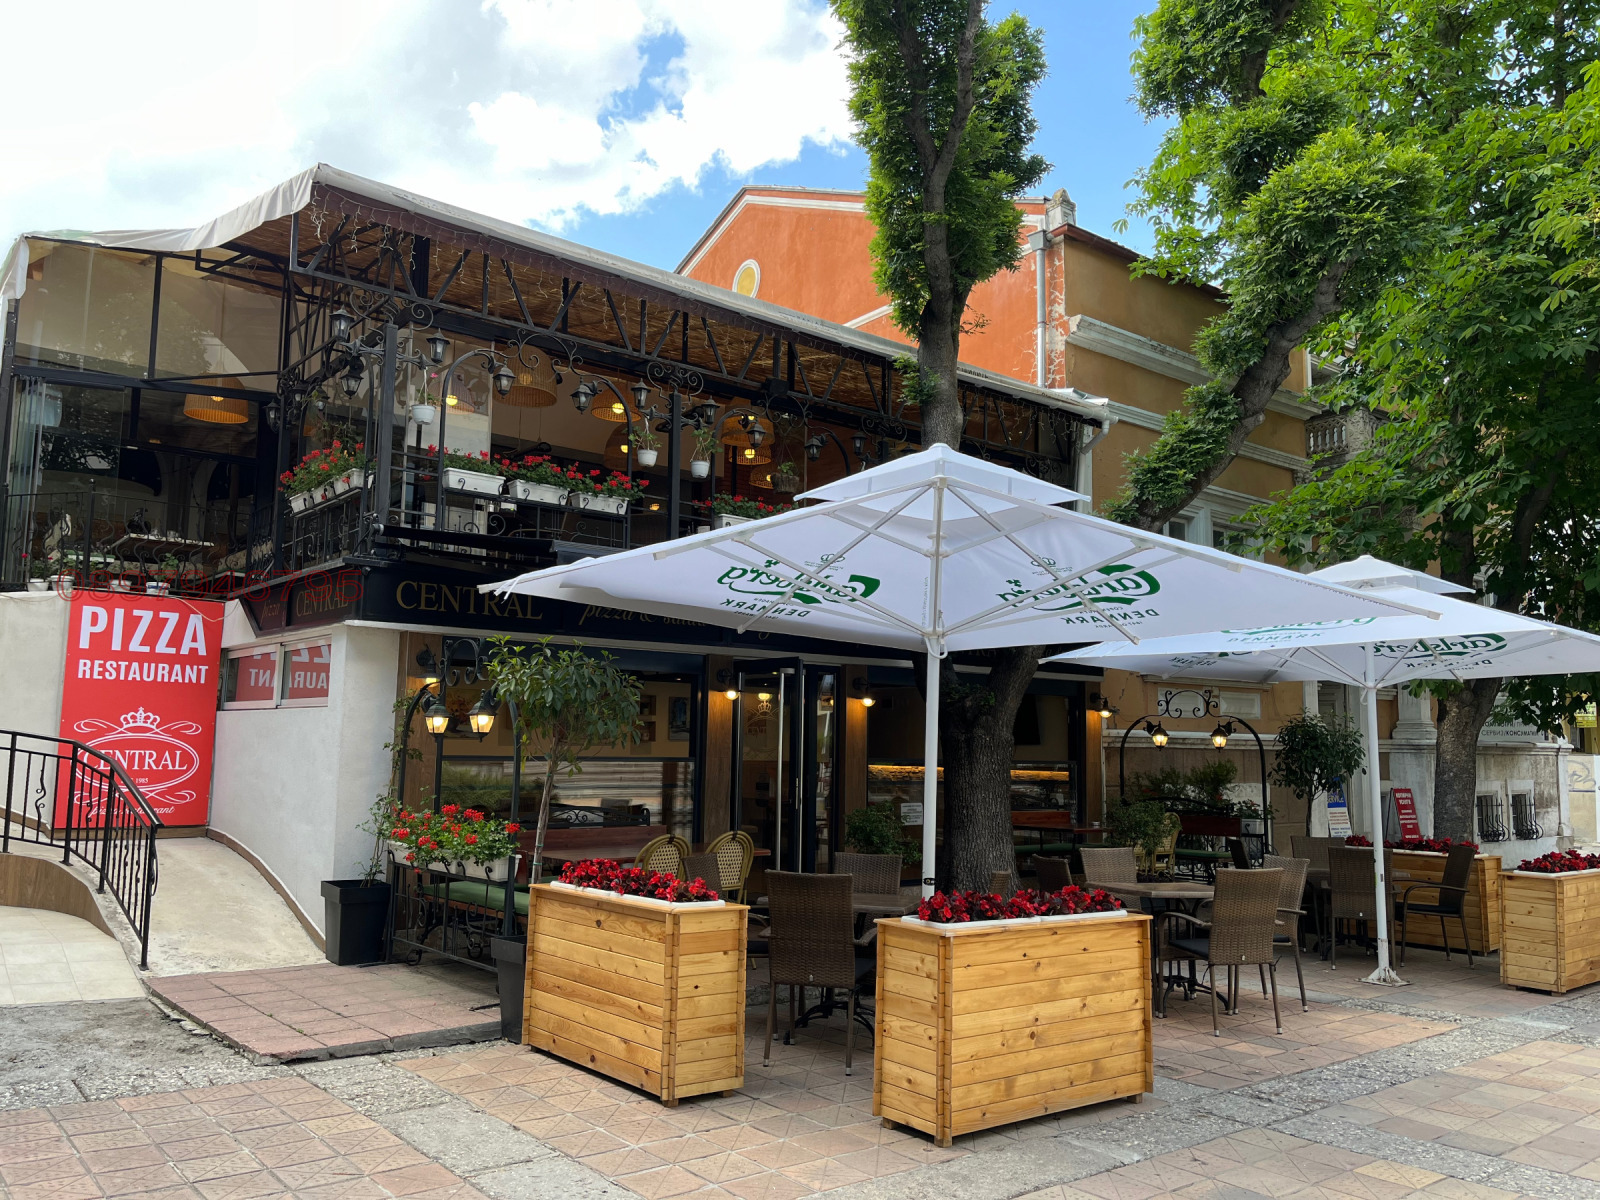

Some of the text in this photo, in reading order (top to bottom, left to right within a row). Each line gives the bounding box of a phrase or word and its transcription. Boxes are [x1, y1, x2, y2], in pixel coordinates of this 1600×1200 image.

[296, 581, 349, 617] CENTRAL
[396, 580, 543, 620] CENTRAL
[79, 605, 206, 656] PIZZA
[78, 659, 208, 684] RESTAURANT
[84, 750, 188, 770] CENTRAL
